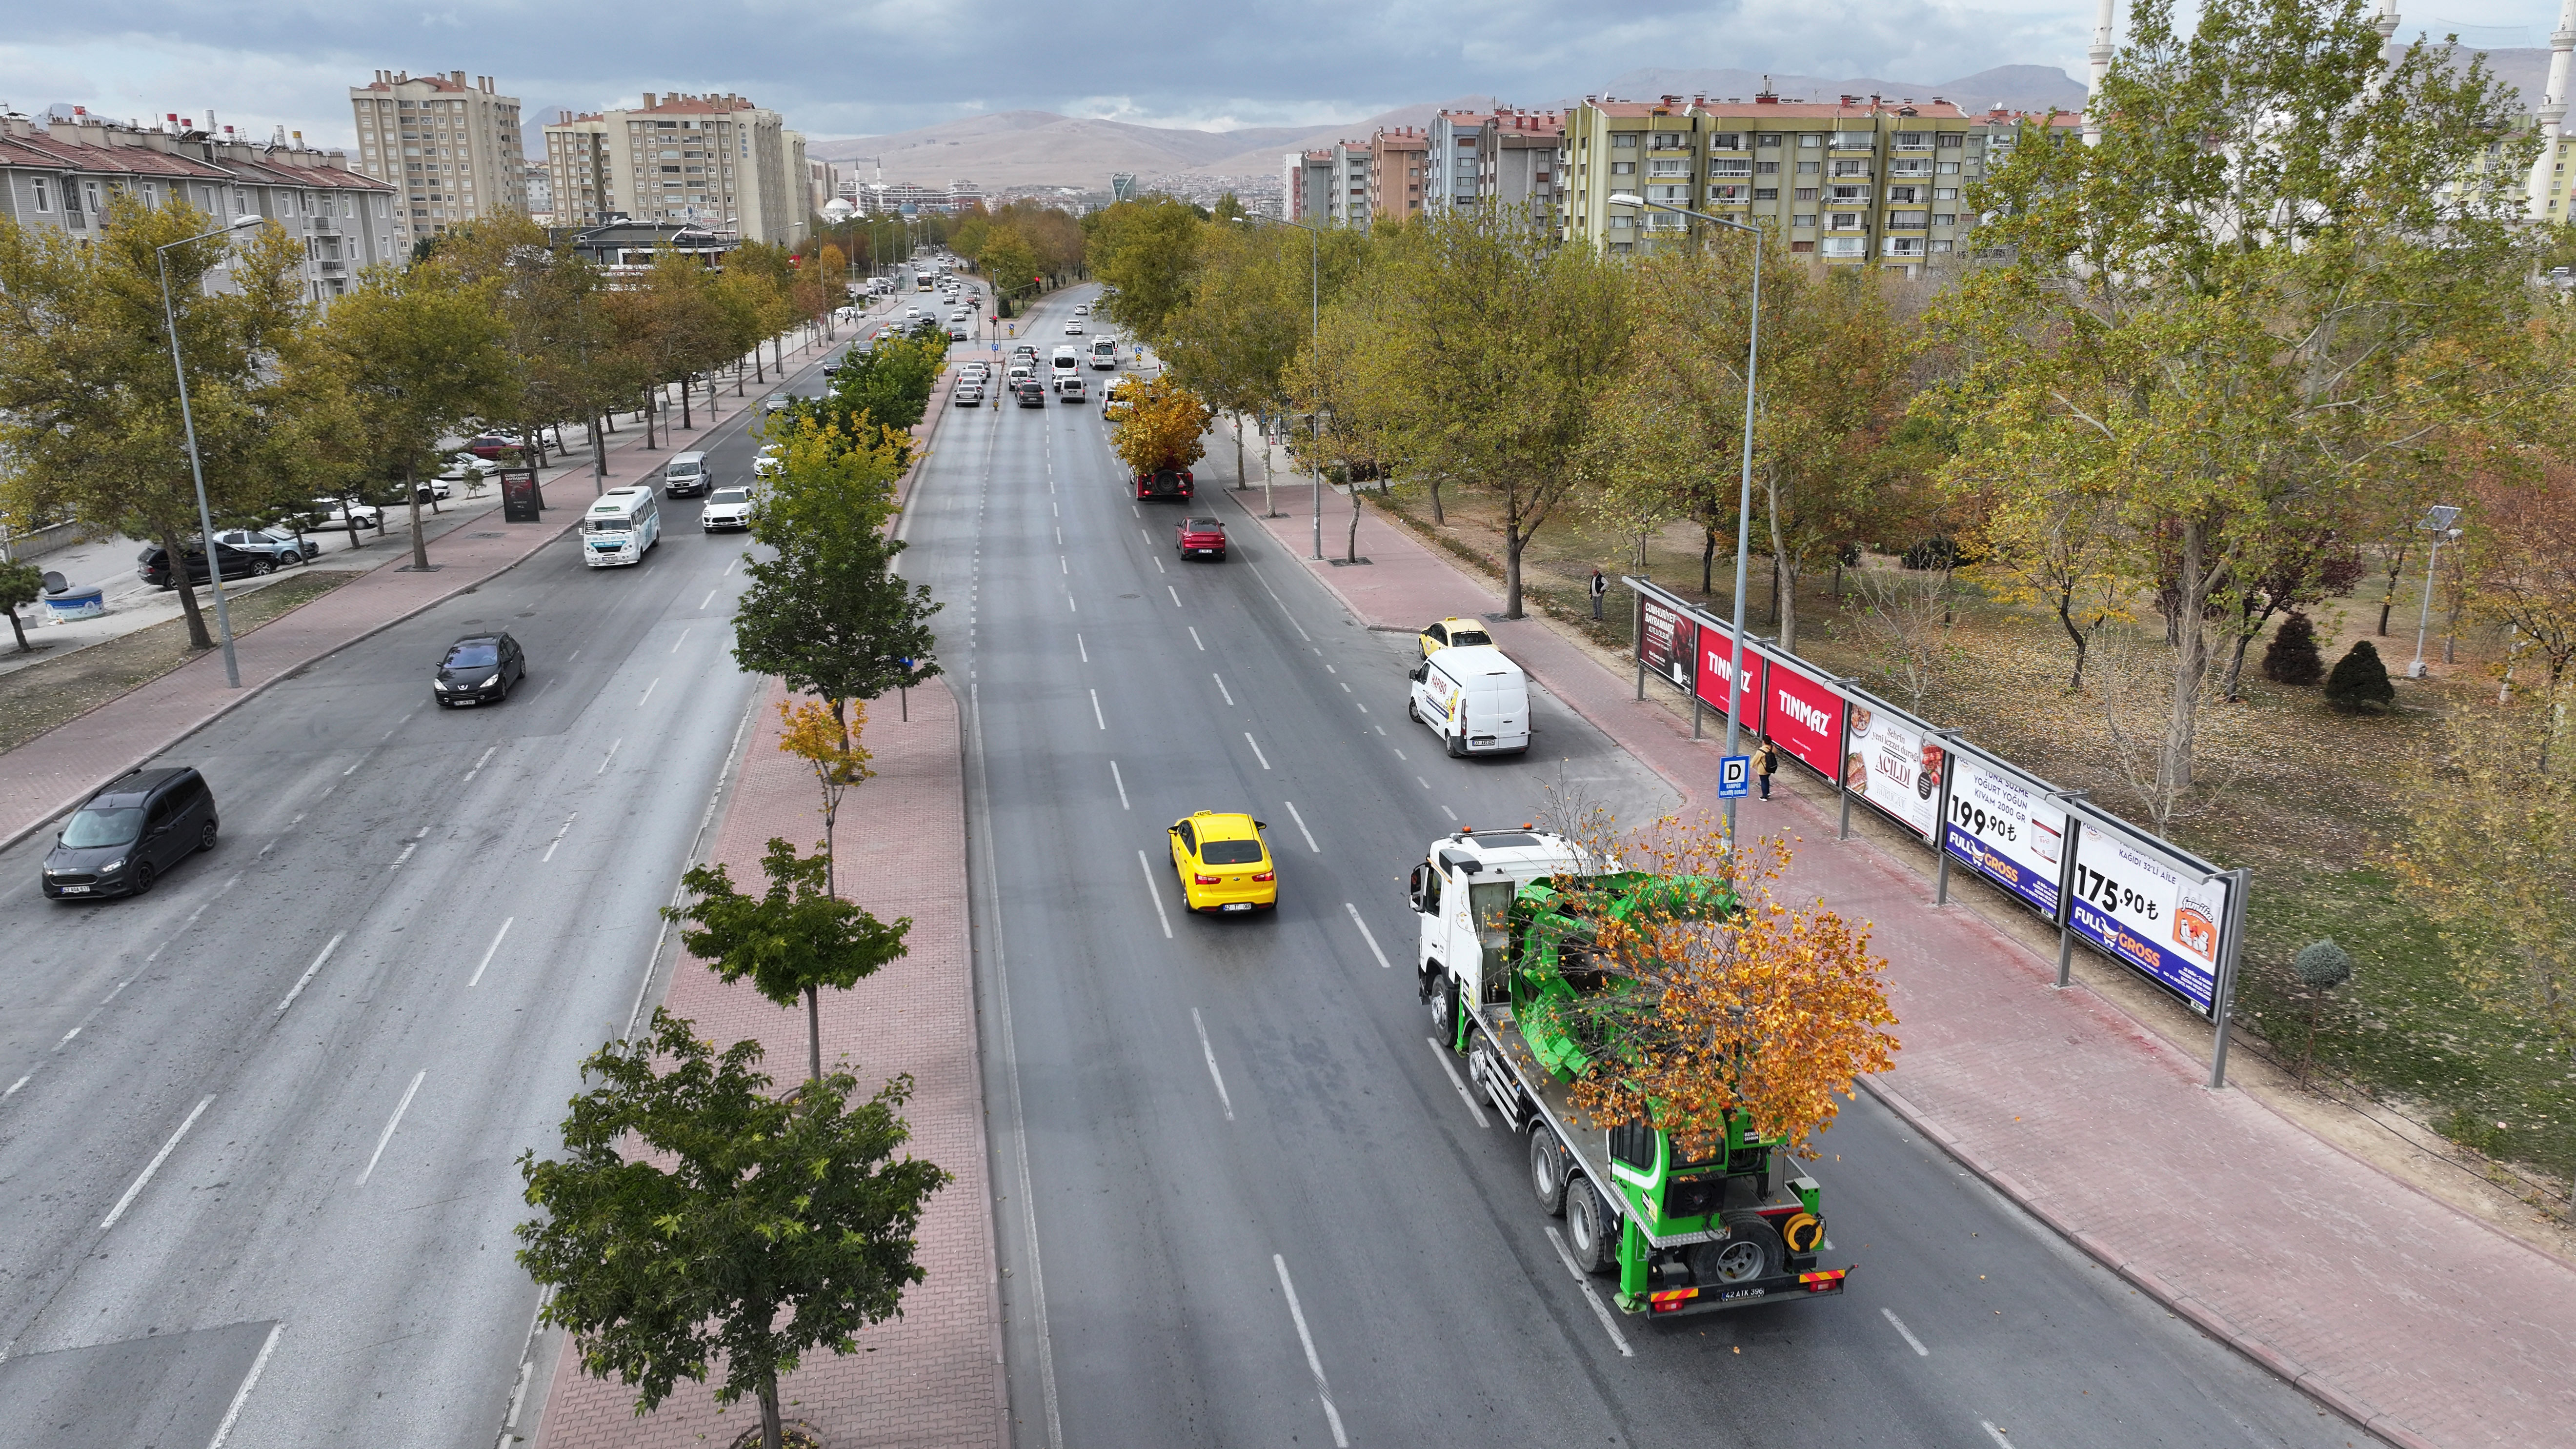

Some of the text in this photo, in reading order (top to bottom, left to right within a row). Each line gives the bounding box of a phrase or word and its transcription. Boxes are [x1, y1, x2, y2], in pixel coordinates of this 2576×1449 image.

[1645, 602, 1676, 624] CUMHURİYET
[1645, 613, 1674, 634] BAYRAMIMIZ
[1648, 625, 1669, 641] KUTLU OLSUN
[1431, 673, 1447, 695] HARIBO
[1708, 651, 1751, 693] TINMZ
[1779, 689, 1830, 737] TINMAZ
[1872, 732, 1884, 743] yeni
[1885, 737, 1900, 751] lezzet
[1901, 745, 1919, 763] durağı
[1887, 727, 1905, 745] Şehrin
[1728, 764, 1741, 781] D
[1876, 753, 1911, 785] AÇILDI
[1974, 775, 2028, 811] YOĞURT YOĞUN
[1974, 788, 2026, 824] KIVAM 2000 GR
[1949, 831, 1972, 855] FULL
[1984, 853, 2019, 882] GROSS
[2119, 849, 2141, 866] KAĞIDI
[2160, 871, 2176, 885] AİLE
[2074, 906, 2102, 933] FULL
[2181, 897, 2213, 923] familia
[2118, 933, 2160, 967] GROSS
